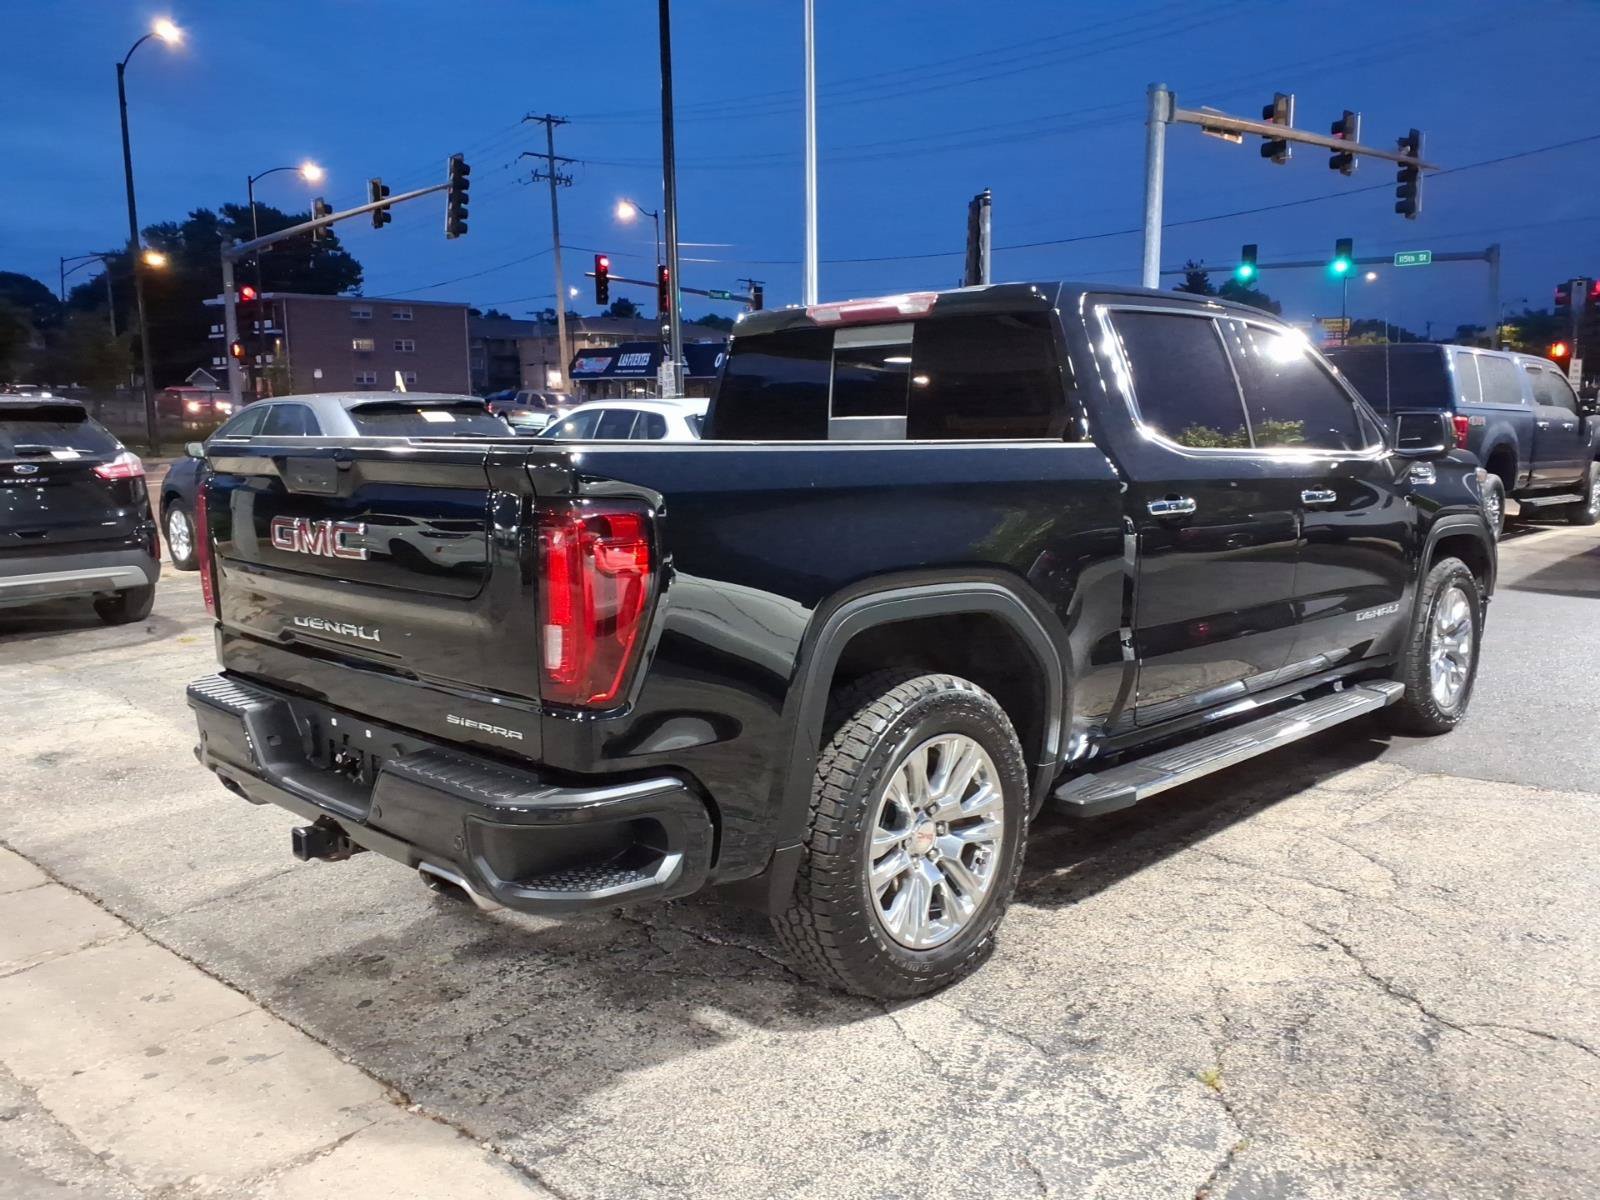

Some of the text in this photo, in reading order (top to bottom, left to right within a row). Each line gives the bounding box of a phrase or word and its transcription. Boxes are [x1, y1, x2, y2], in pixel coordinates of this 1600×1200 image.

[270, 515, 368, 560] GMC
[293, 616, 381, 642] DENALI
[446, 714, 524, 740] SIERRA
